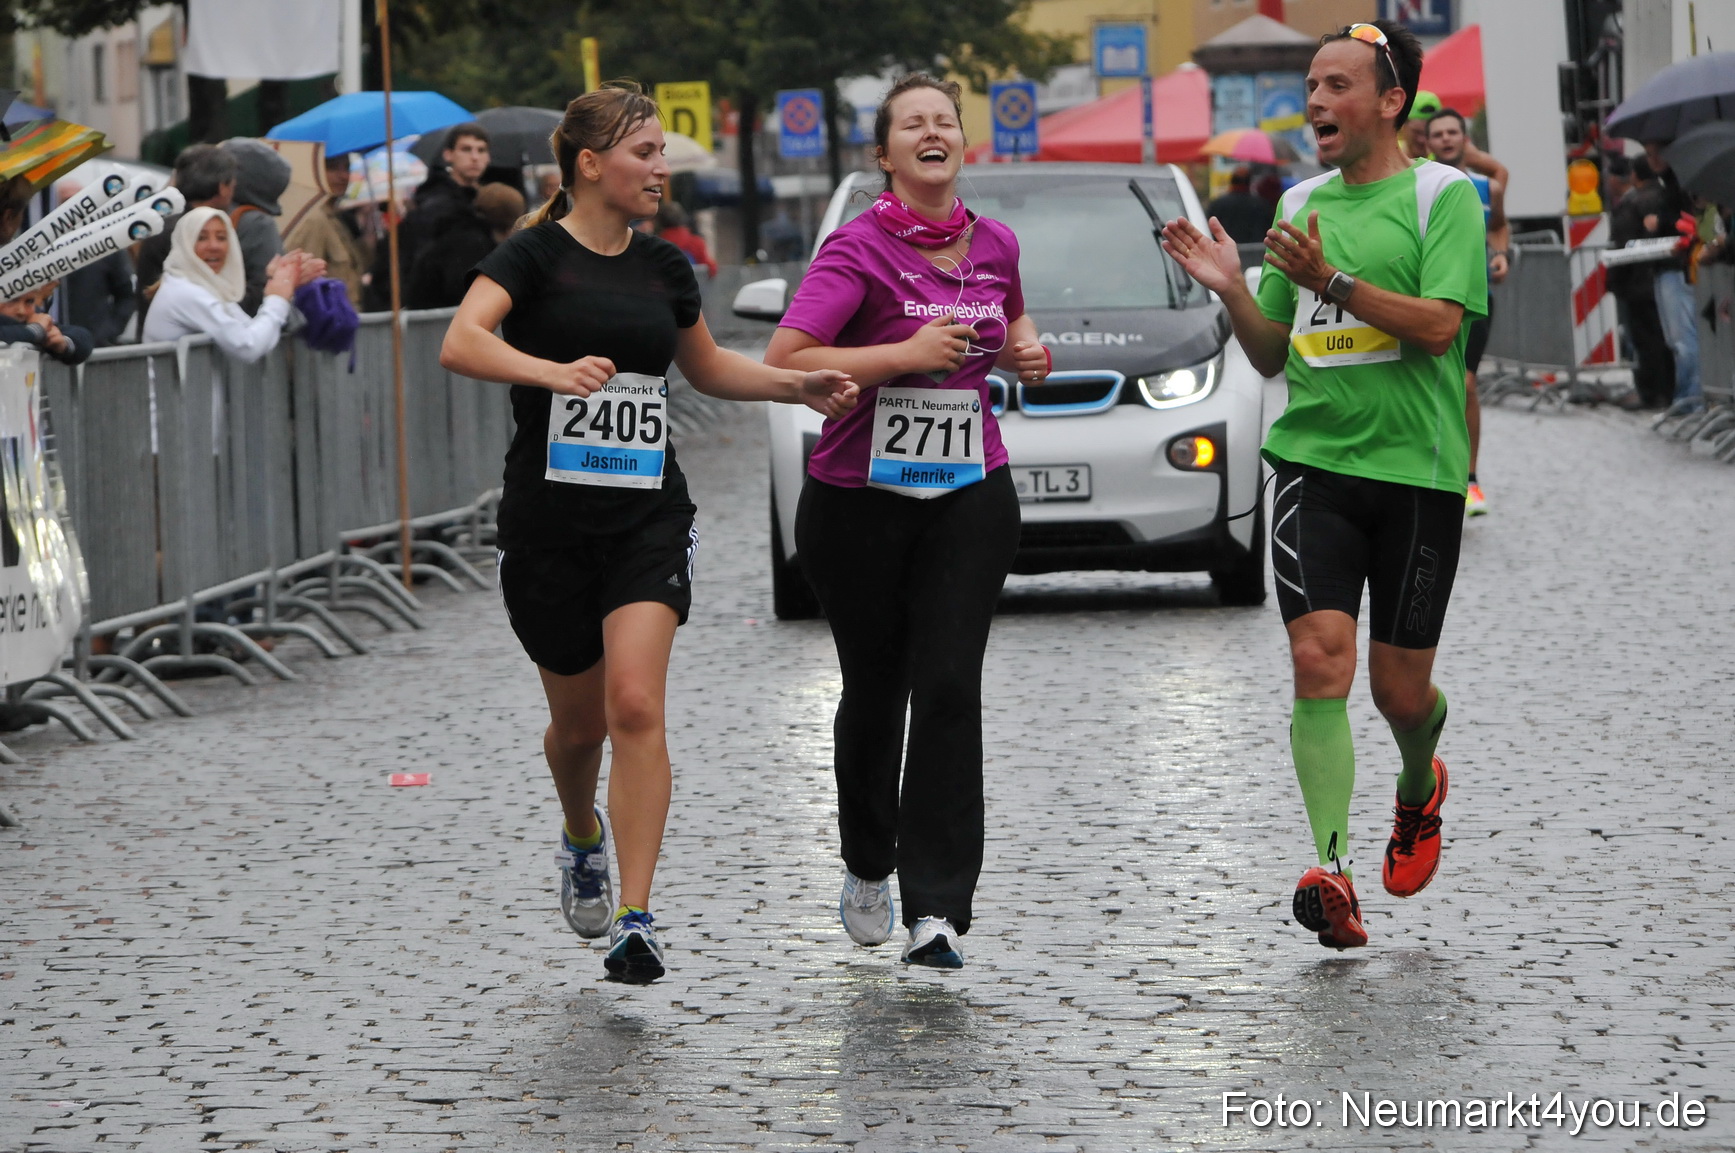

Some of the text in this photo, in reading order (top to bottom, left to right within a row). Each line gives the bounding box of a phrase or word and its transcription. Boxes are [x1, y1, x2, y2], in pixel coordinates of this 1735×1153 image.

[672, 107, 698, 138] D
[50, 196, 97, 239] BMW
[0, 236, 119, 299] bmw-laufsport
[1326, 335, 1354, 351] Udo
[599, 382, 654, 396] Neumarkt
[879, 397, 969, 412] PARTL Neumarkt
[562, 398, 662, 444] 2405
[884, 414, 972, 458] 2711
[581, 451, 638, 471] Jasmin
[901, 467, 955, 484] Henrike
[1028, 469, 1080, 493] TL 3
[1406, 545, 1439, 635] 2XU
